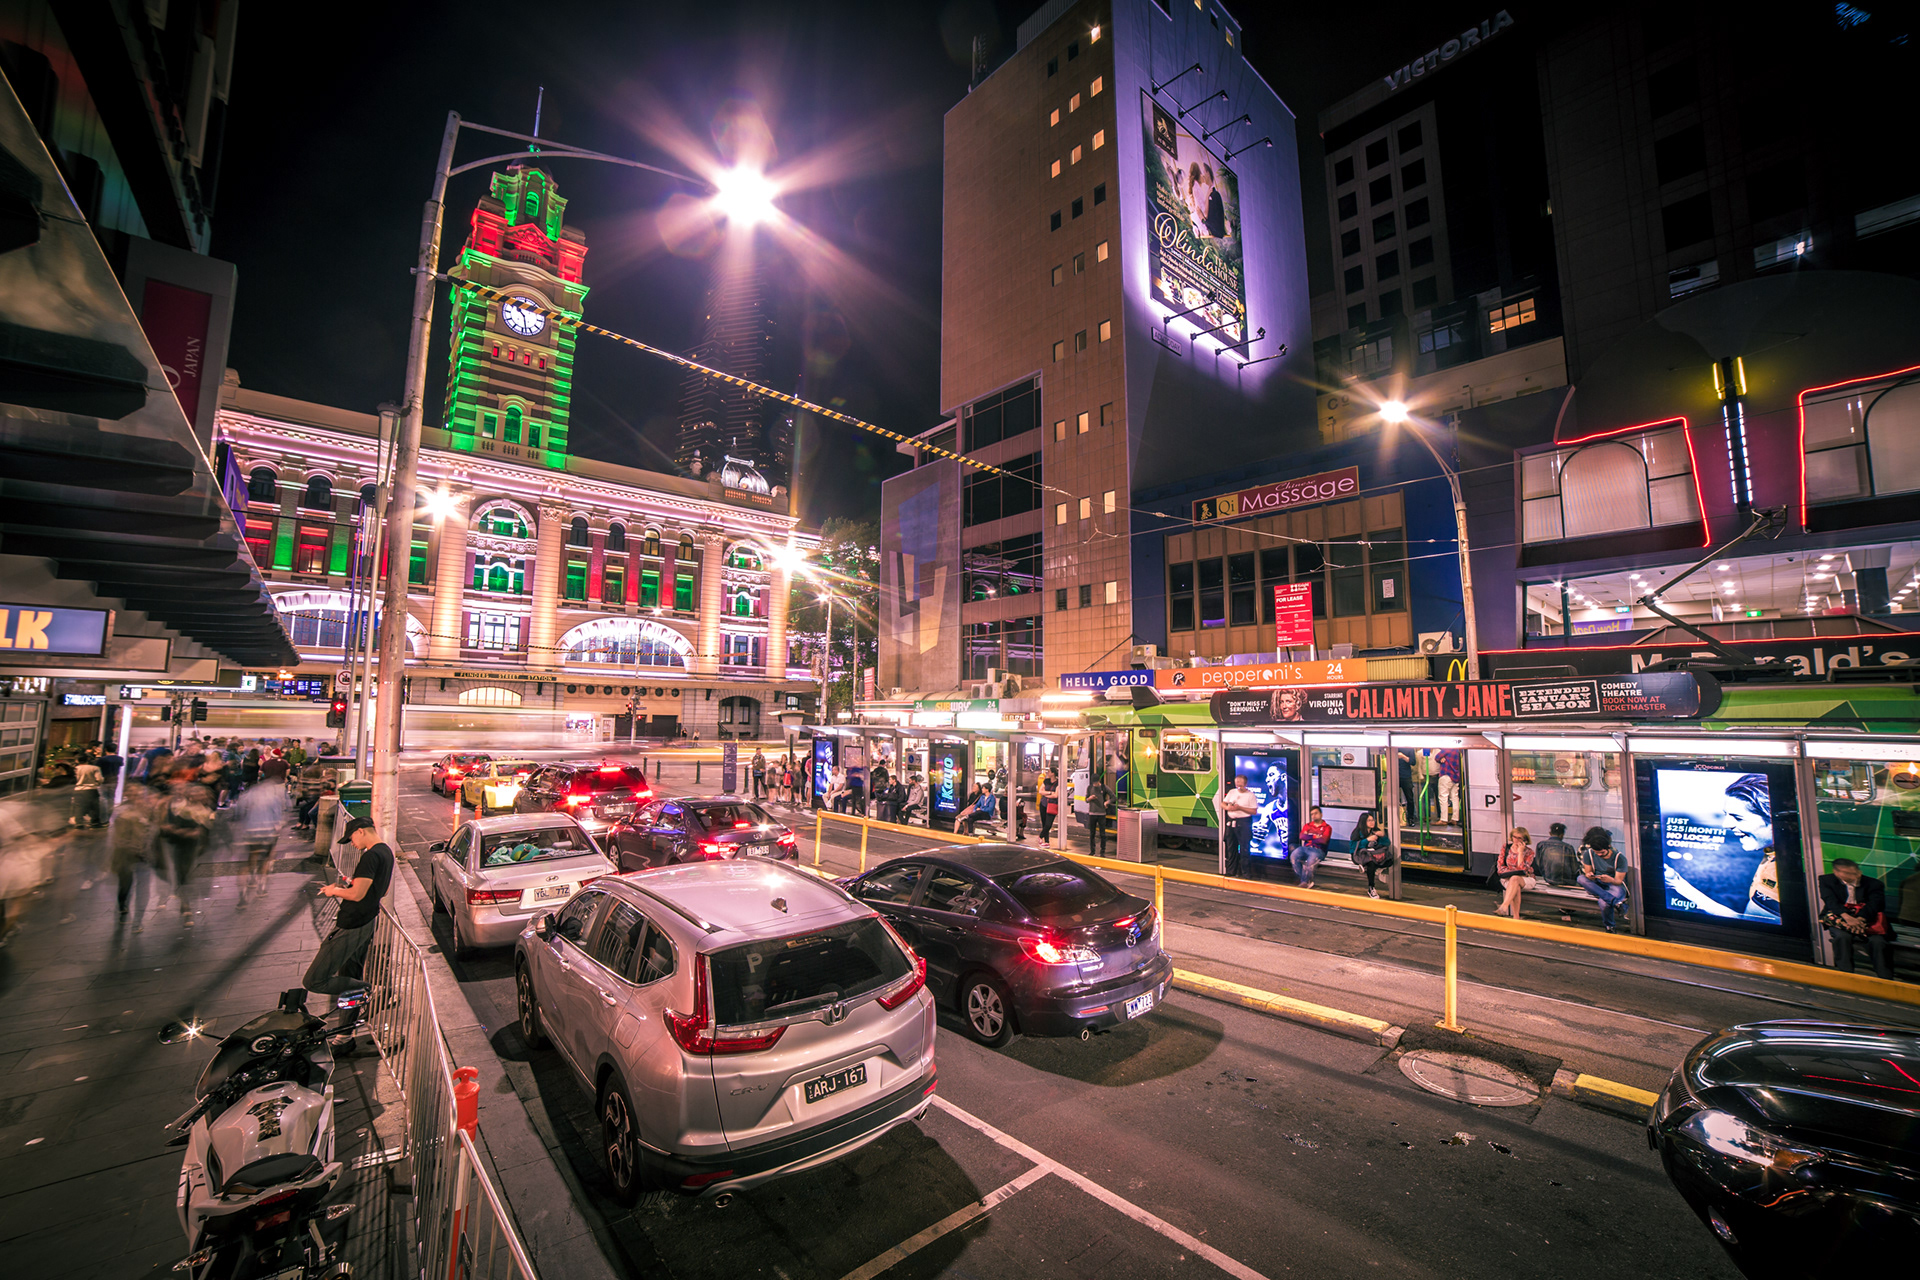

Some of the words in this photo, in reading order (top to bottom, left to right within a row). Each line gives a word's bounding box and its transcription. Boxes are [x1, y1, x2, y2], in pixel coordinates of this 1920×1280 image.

[1384, 9, 1514, 91] VICTORIA
[1155, 212, 1215, 274] Olinda
[1214, 265, 1239, 291] HOUSE
[183, 336, 201, 378] JAPAN
[1275, 480, 1316, 491] Chinese
[1218, 499, 1235, 516] Qi
[1242, 477, 1355, 512] Massage
[1327, 663, 1343, 675] 24
[1065, 676, 1104, 688] HELLA
[1109, 674, 1148, 686] GOOD
[1202, 665, 1304, 686] pepperoni's
[1519, 685, 1591, 697] EXTENDED
[1601, 682, 1638, 690] COMEDY
[1519, 691, 1591, 704] JANUARY
[1601, 689, 1643, 697] THEATRE
[915, 701, 923, 709] 24
[987, 700, 996, 709] 24
[1309, 699, 1344, 708] VIRGINIA
[1346, 686, 1447, 719] CALAMITY
[1452, 684, 1512, 717] JANE
[1521, 699, 1591, 712] SEASON
[1602, 696, 1626, 704] BOOK
[1627, 696, 1648, 704] NOW
[935, 701, 971, 713] SUBWAY
[1327, 707, 1344, 715] GAY
[1603, 703, 1667, 712] TICKETMASTER
[941, 756, 958, 801] Kayo
[1666, 817, 1689, 825] JUST
[1683, 833, 1725, 843] LOCK-IN
[1666, 839, 1722, 851] CONTRACT
[1670, 898, 1696, 910] Kayo
[814, 1077, 837, 1098] ARJ
[844, 1067, 864, 1086] 167
[730, 1082, 770, 1097] CR-V
